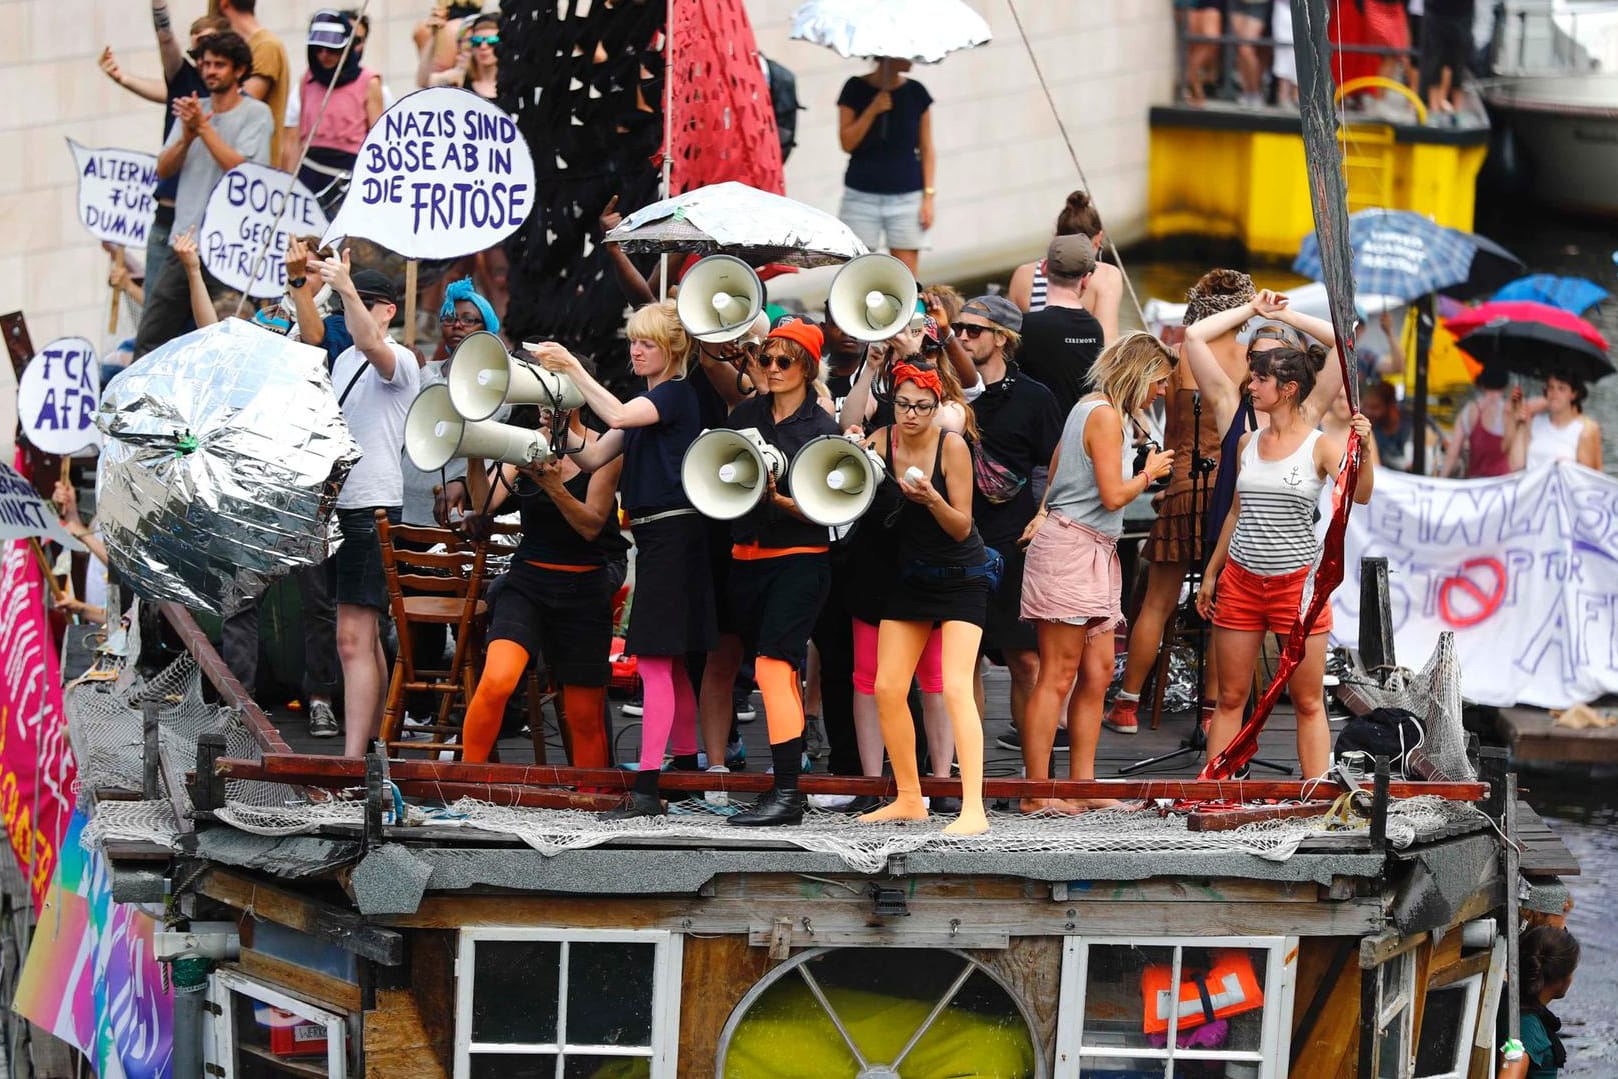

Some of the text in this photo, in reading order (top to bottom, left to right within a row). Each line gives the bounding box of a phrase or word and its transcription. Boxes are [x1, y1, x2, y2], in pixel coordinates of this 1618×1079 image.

[385, 110, 517, 144] NAZIS SIND
[366, 139, 512, 175] BÖSE AB IN
[108, 184, 152, 213] FÜR
[227, 171, 315, 226] BOOTE
[362, 175, 528, 234] DIE FRITÖSE
[86, 205, 145, 240] DUMM
[42, 349, 94, 392] FCK
[34, 387, 96, 430] AFD
[1512, 584, 1618, 683] AF
